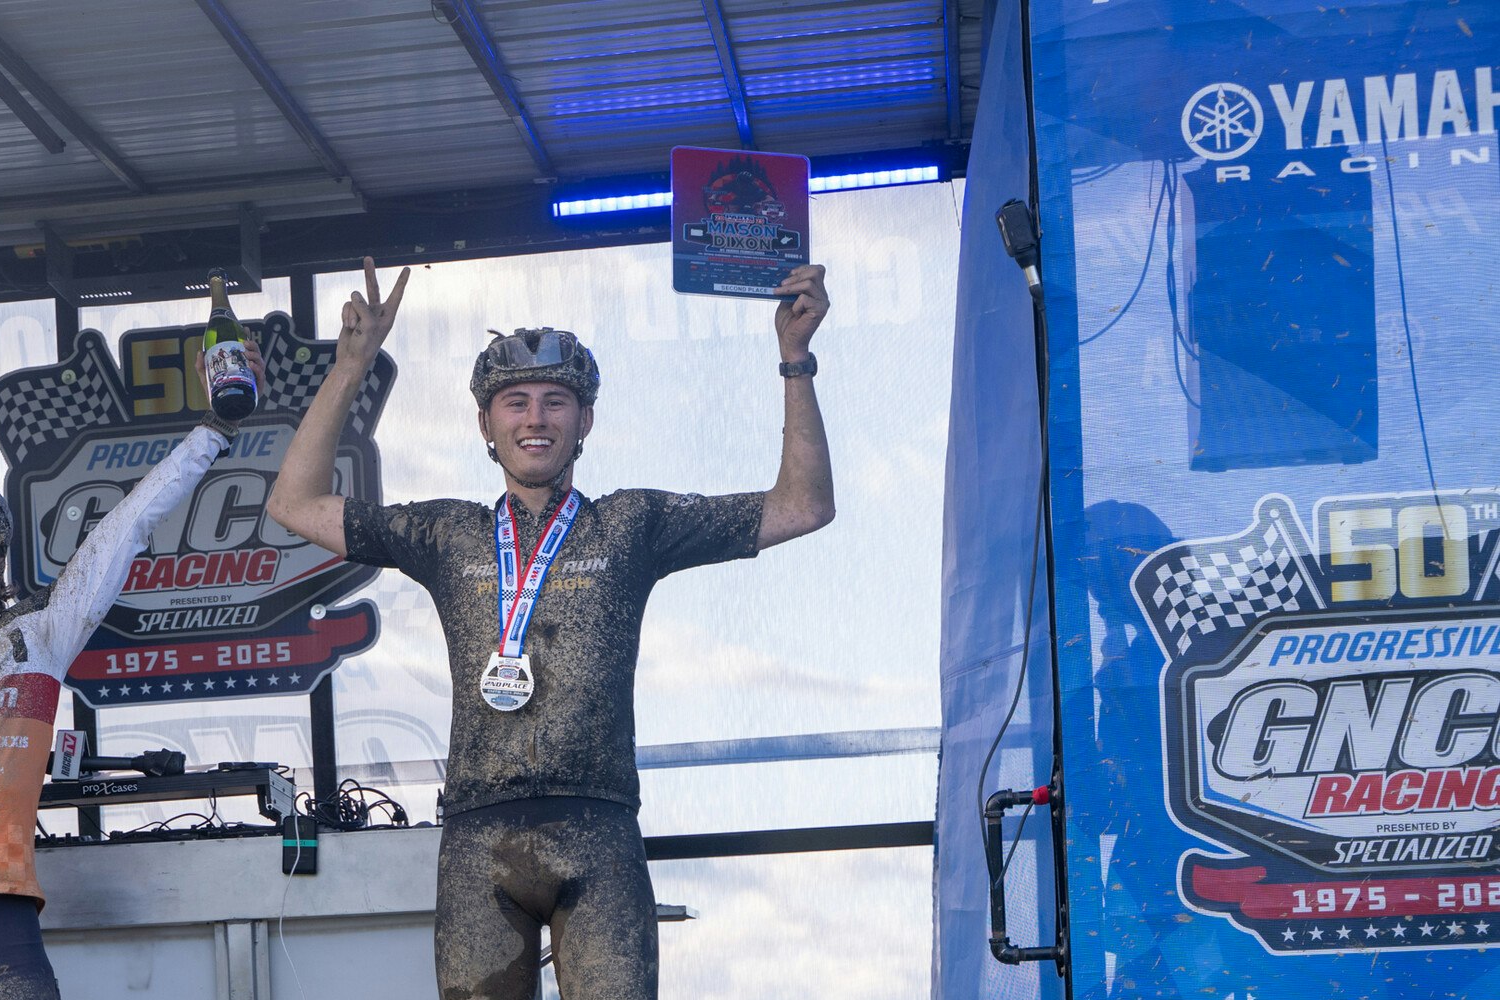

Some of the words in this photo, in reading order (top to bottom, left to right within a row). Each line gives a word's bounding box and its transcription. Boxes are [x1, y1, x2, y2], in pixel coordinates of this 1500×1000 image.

[1269, 67, 1500, 150] YAMAH
[1216, 146, 1490, 183] RACIN
[707, 220, 777, 239] MASON
[713, 235, 773, 251] DIXON
[87, 431, 277, 471] PROGIVE
[1329, 505, 1470, 602] 50
[1471, 503, 1498, 520] TH
[124, 550, 278, 592] RACING
[170, 596, 214, 606] PRESENTED
[216, 594, 232, 604] BY
[134, 605, 259, 633] SPECIALIZED
[106, 650, 179, 674] 1975
[217, 642, 291, 667] 2025
[1376, 823, 1434, 833] PRESENTED
[1438, 821, 1457, 831] BY
[1329, 835, 1493, 864] SPECIALIZED
[1292, 887, 1386, 913] 1975
[1439, 883, 1500, 907] 202
